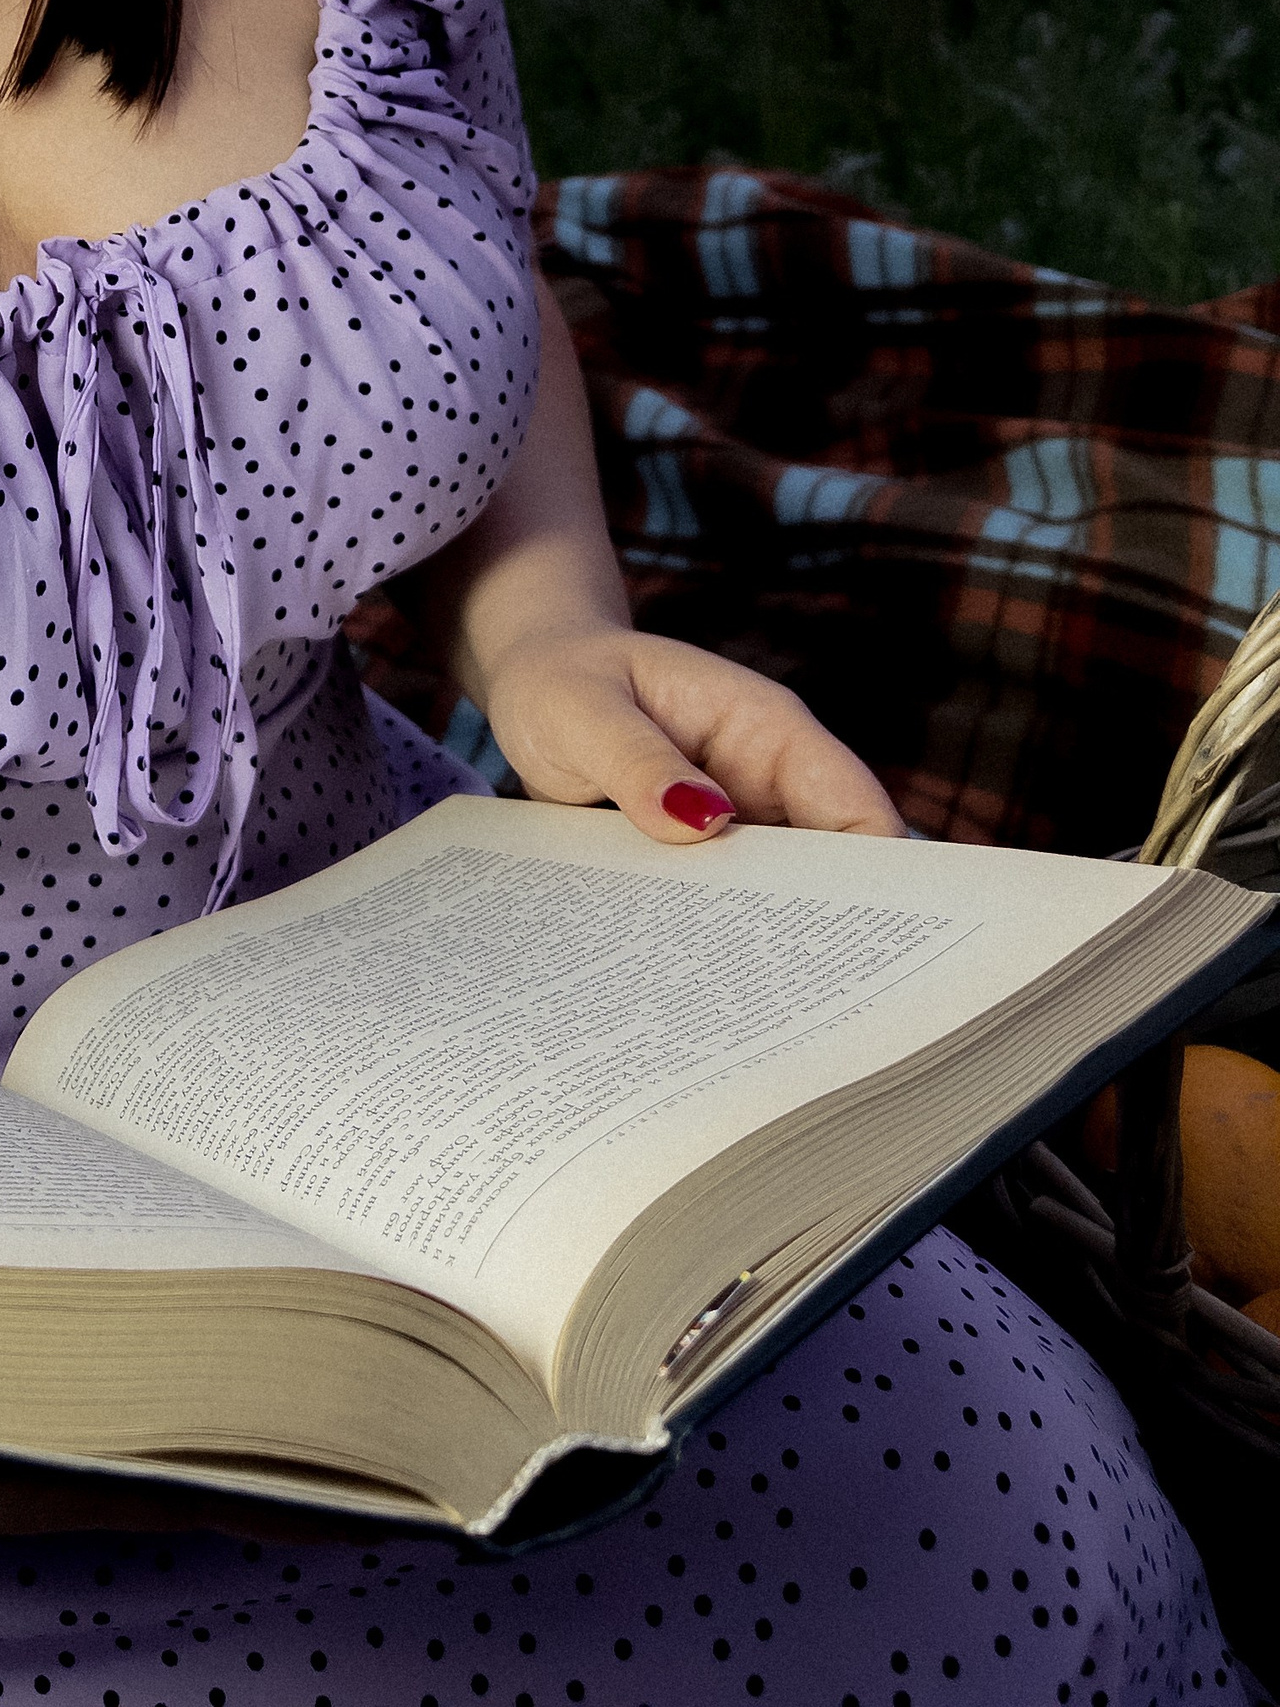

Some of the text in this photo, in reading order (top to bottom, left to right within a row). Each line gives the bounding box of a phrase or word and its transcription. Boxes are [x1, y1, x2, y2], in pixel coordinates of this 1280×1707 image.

[523, 1148, 546, 1165] он
[400, 1172, 424, 1204] мог
[466, 1151, 524, 1203] братьев
[380, 1211, 400, 1237] бы
[393, 1195, 425, 1243] готов
[418, 1172, 480, 1254] улавливая
[442, 1210, 464, 1238] его
[457, 1170, 520, 1245] посылает
